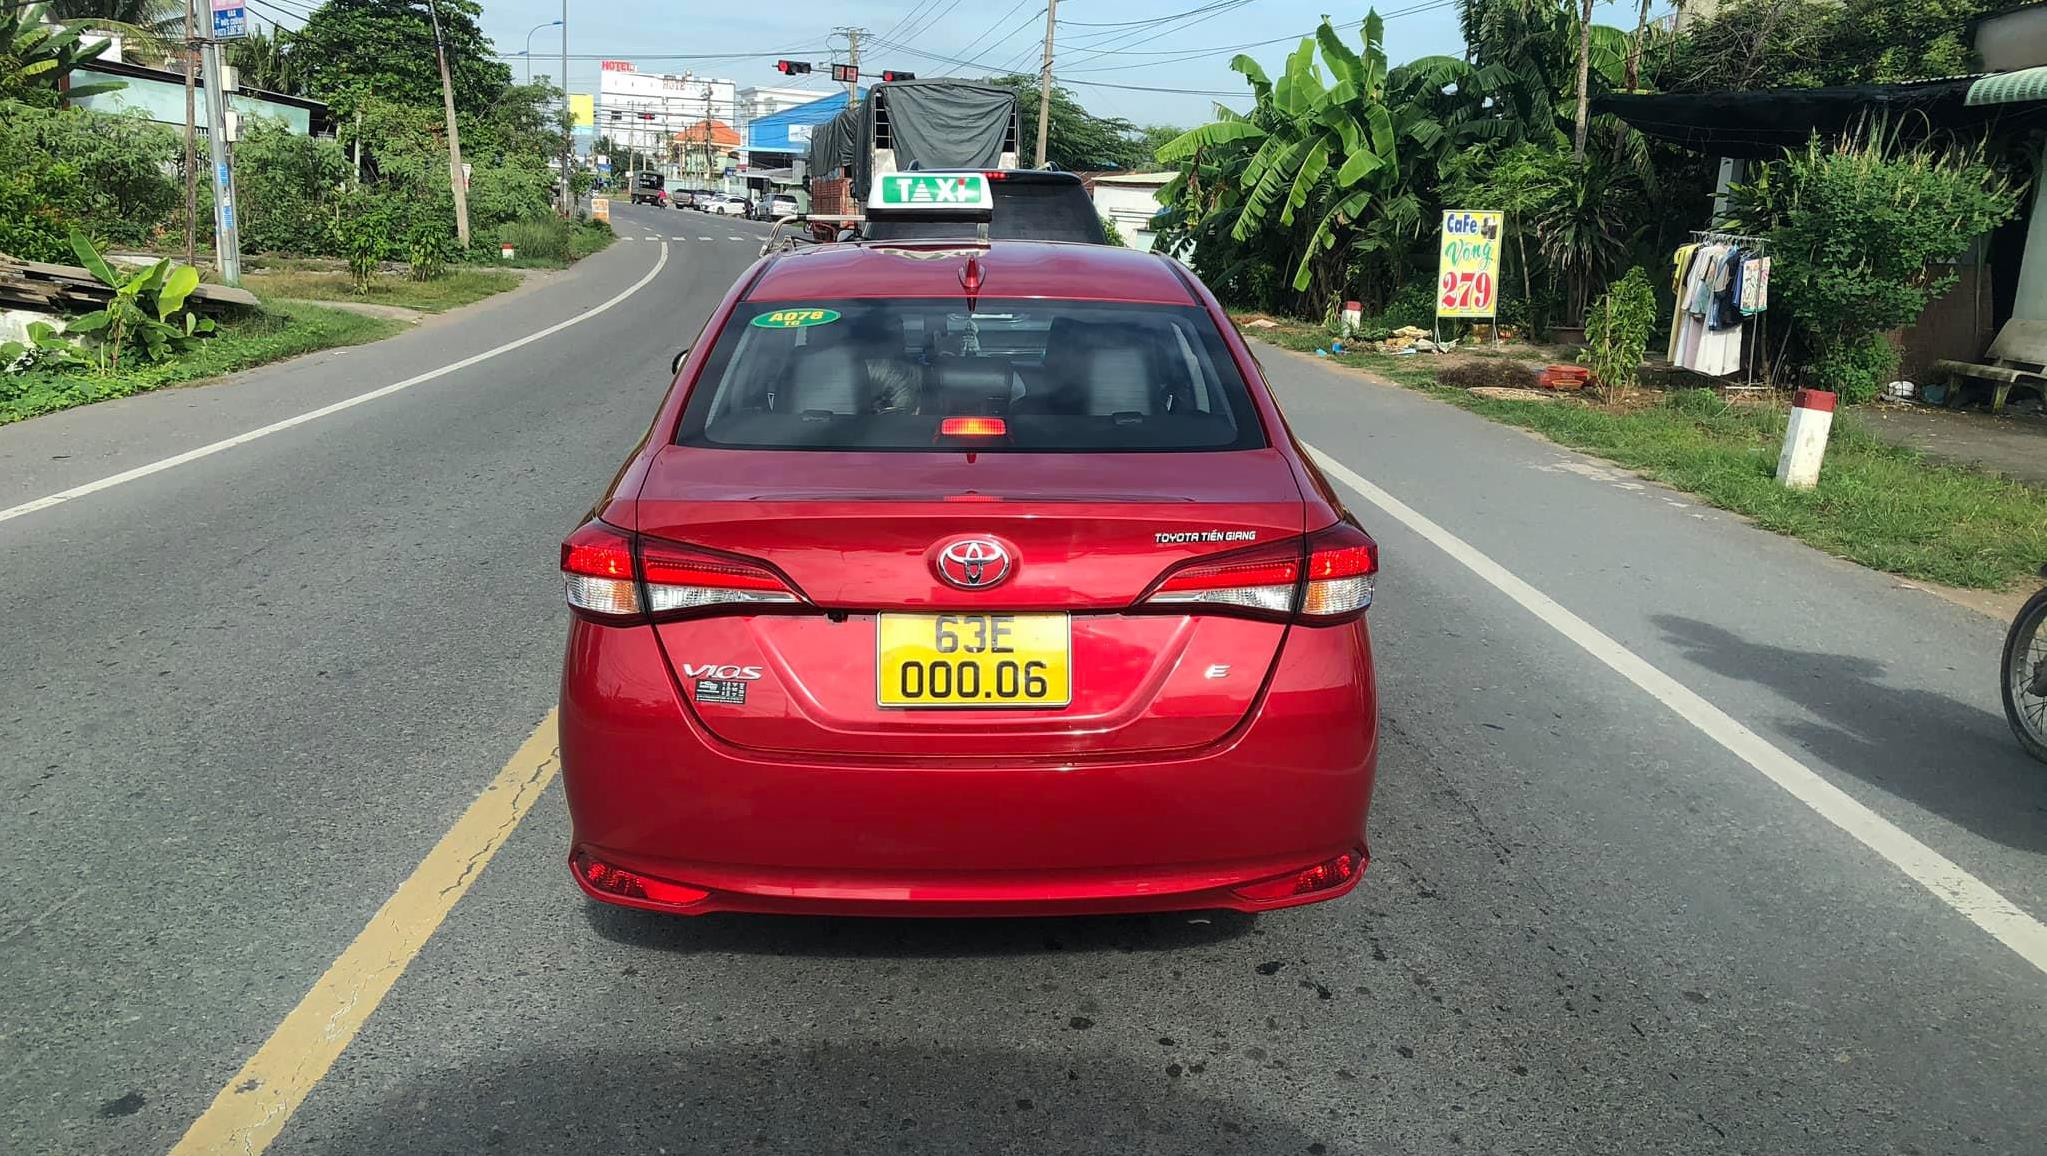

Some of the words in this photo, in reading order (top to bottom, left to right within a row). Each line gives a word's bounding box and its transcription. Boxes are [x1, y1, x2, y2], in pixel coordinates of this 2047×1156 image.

[601, 60, 636, 72] HOTEL
[1442, 271, 1493, 309] 279
[768, 311, 824, 322] A078
[1155, 532, 1200, 543] TOYOTA
[1225, 531, 1256, 541] GIANG
[935, 614, 1015, 654] 63E
[683, 663, 763, 680] VIOS
[901, 660, 1047, 698] 000.06
